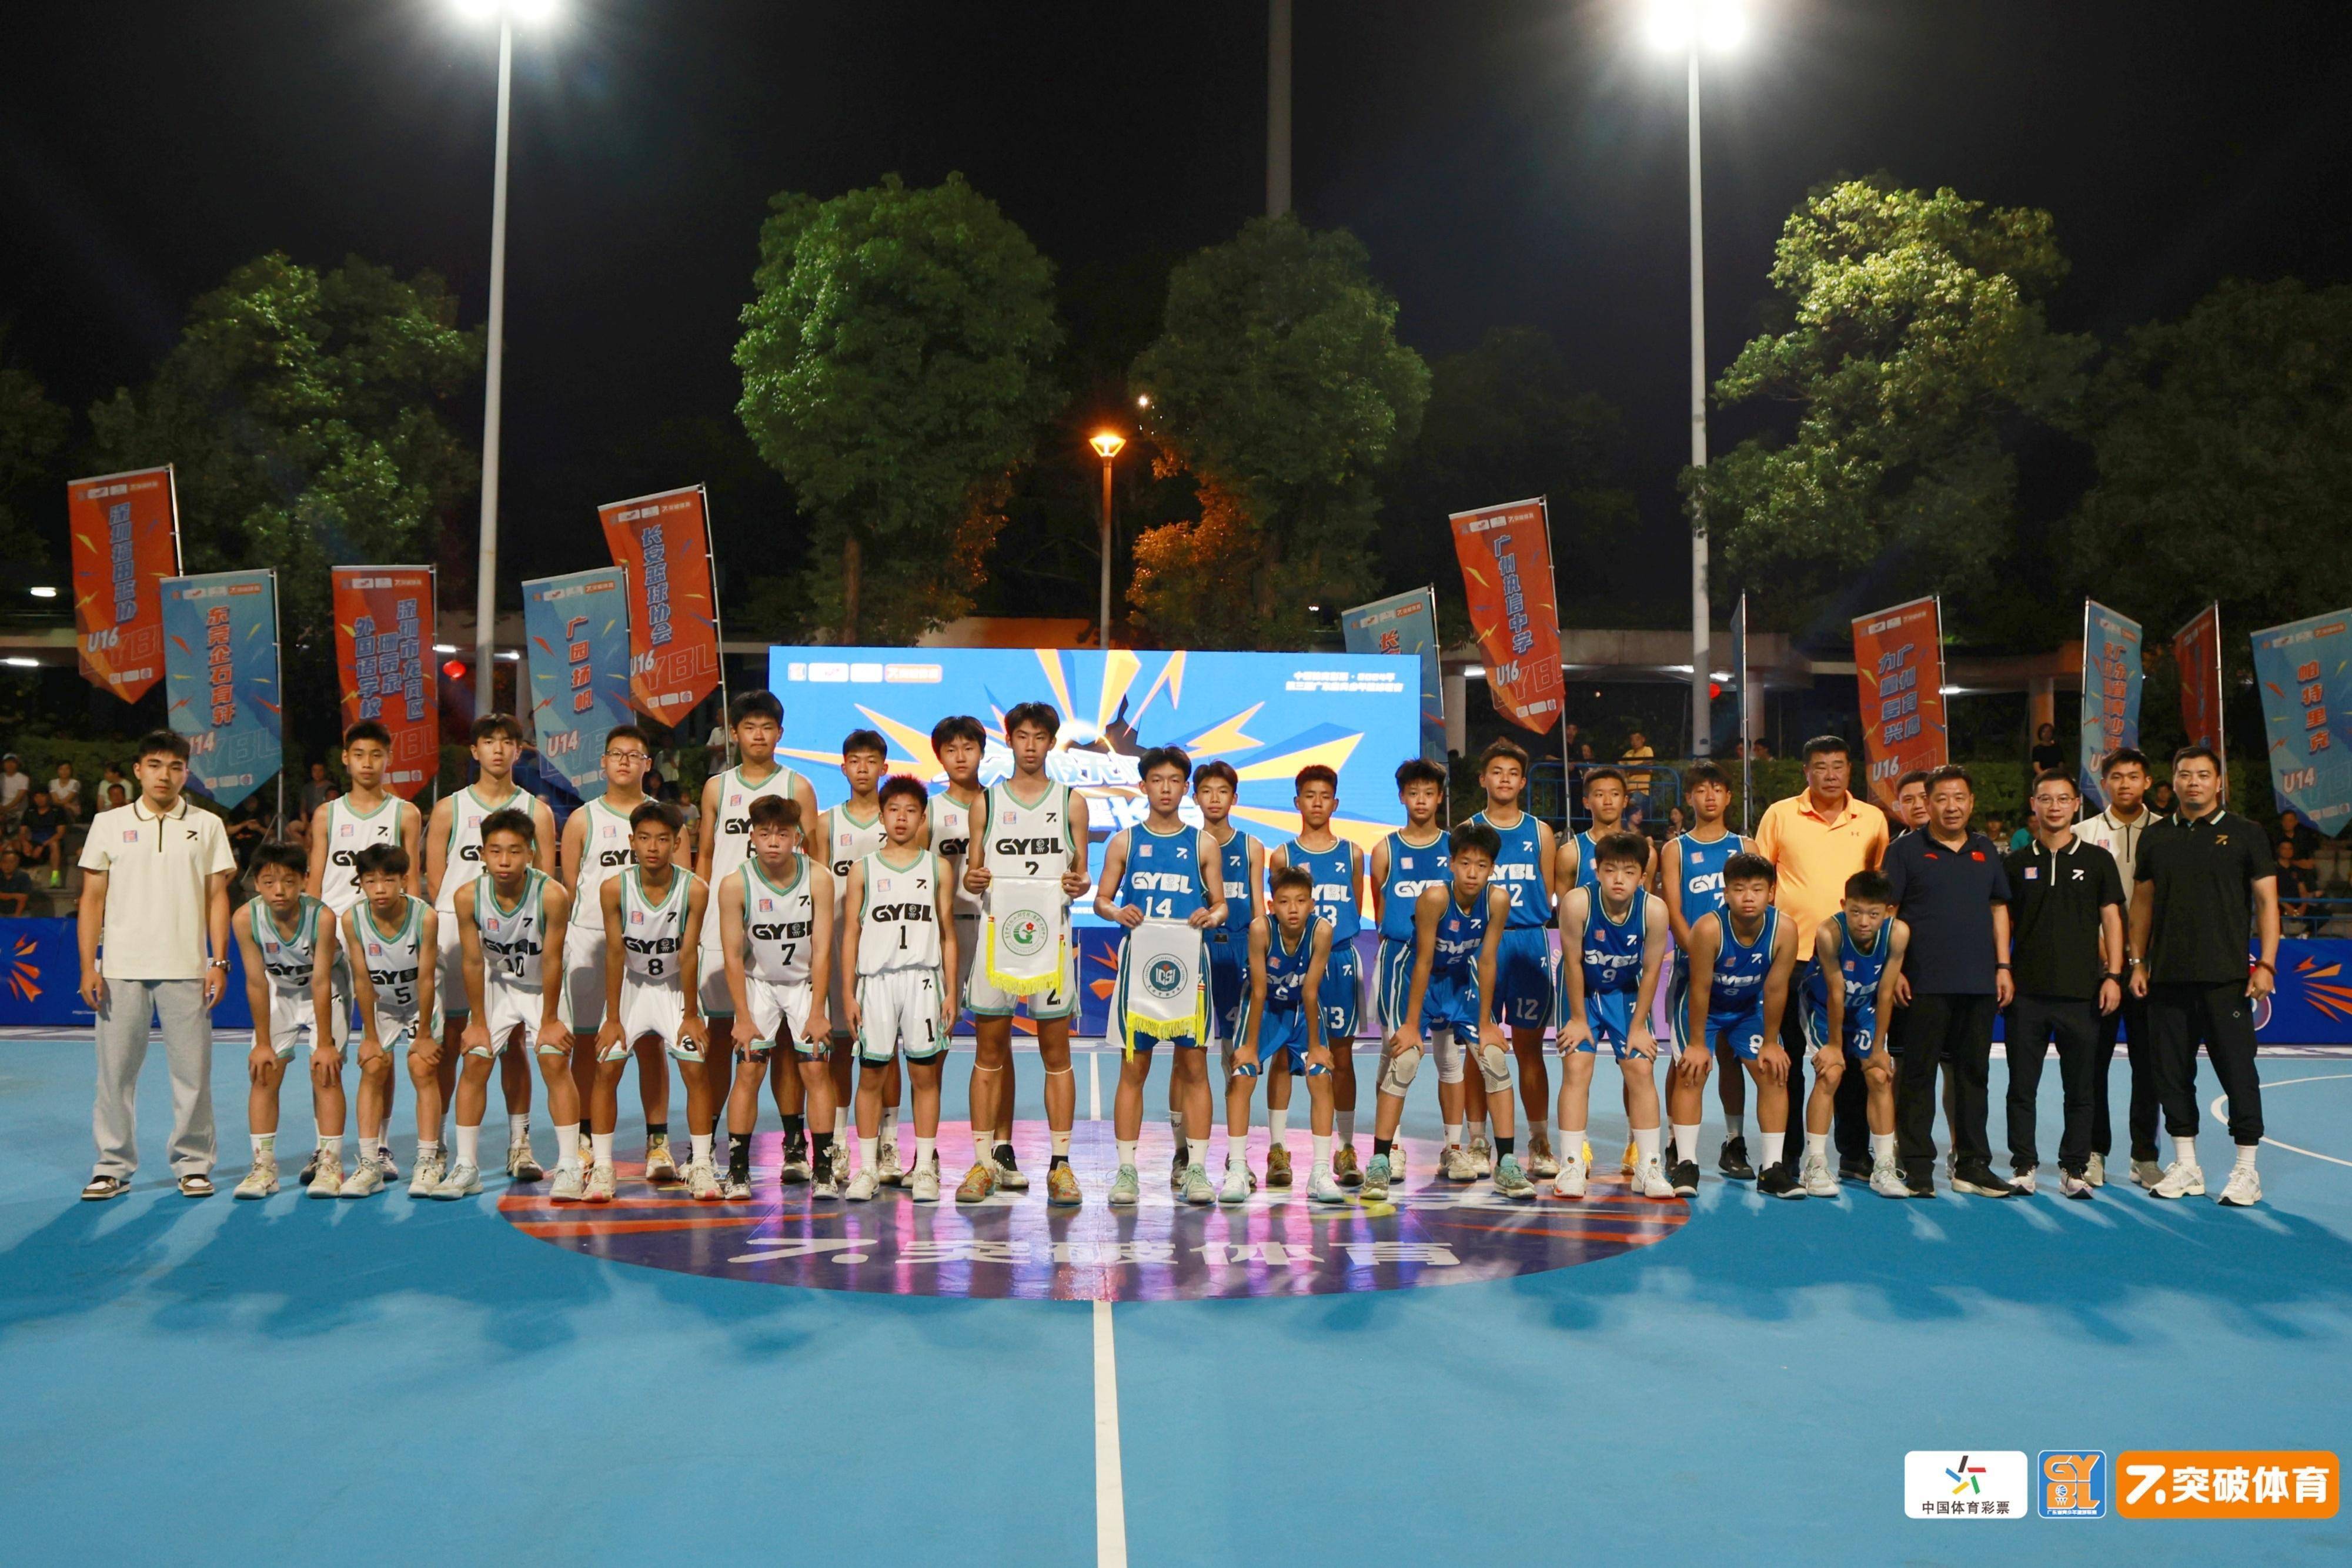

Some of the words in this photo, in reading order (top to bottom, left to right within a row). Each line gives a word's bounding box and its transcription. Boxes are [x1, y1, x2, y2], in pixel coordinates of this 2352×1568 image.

[1494, 534, 1533, 654] 广州执信中学
[88, 627, 119, 653] U16
[630, 650, 656, 677] U16
[1496, 660, 1521, 687] U16
[2297, 660, 2331, 754] 帕特里克
[189, 731, 216, 755] 14
[546, 730, 579, 758] U14
[1872, 755, 1900, 782] U16
[2283, 767, 2316, 793] U14
[939, 838, 970, 856] GY
[996, 838, 1064, 855] GYBL
[1131, 871, 1194, 894] GYBL
[1223, 882, 1248, 899] BL
[1312, 884, 1351, 902] YBL
[1689, 872, 1725, 894] GY
[872, 903, 933, 922] GYBL
[1145, 897, 1172, 918] 14
[899, 925, 908, 950] 1
[781, 943, 796, 966] 7
[369, 967, 418, 985] GYB
[648, 958, 663, 976] 8
[1602, 969, 1617, 983] 9
[395, 987, 411, 1005] 5
[1516, 998, 1539, 1020] 12
[925, 1018, 935, 1043] 1
